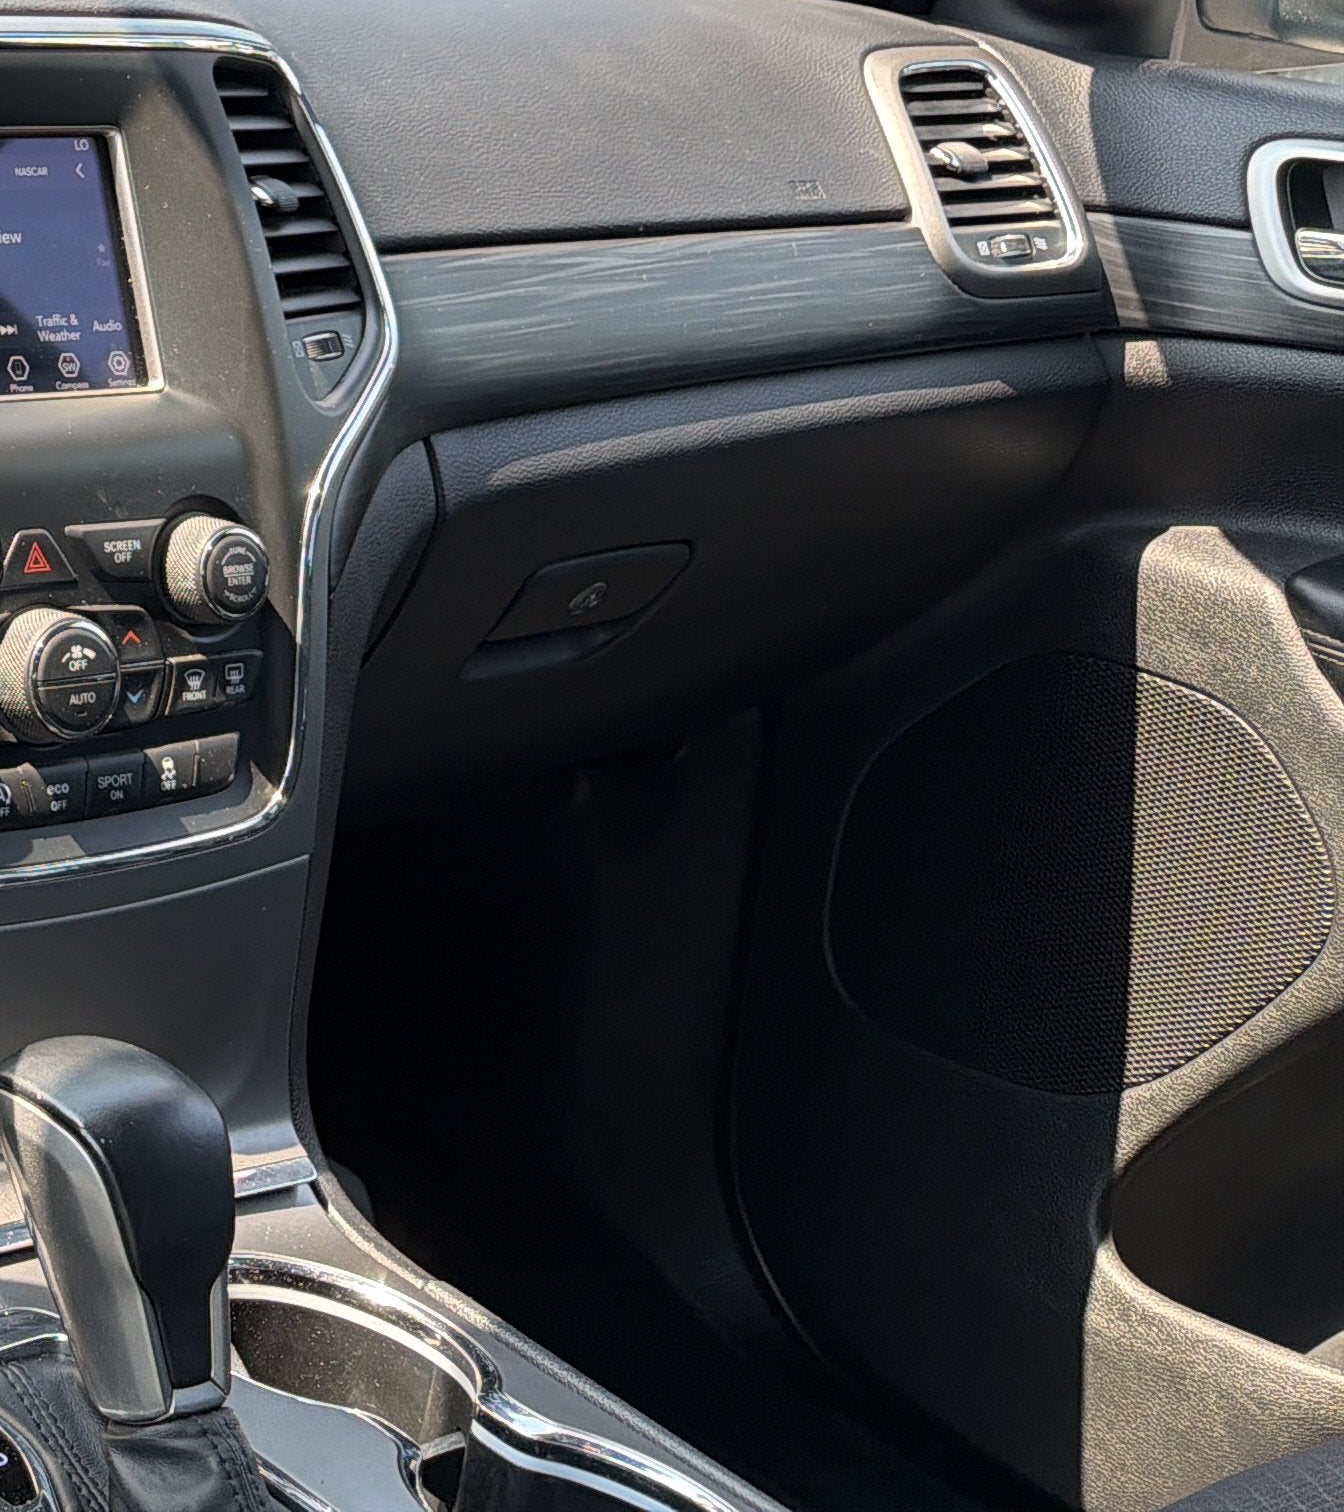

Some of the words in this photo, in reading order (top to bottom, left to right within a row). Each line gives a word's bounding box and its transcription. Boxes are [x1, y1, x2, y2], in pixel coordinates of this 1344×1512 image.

[73, 139, 89, 151] LO
[14, 166, 49, 177] NASCAR
[36, 313, 67, 327] Traffic
[69, 314, 79, 327] &
[93, 319, 123, 332] Audio
[37, 329, 81, 342] Weather
[103, 539, 142, 553] SCREEN
[114, 552, 133, 564] OFF
[223, 563, 255, 574] BROWSE
[227, 576, 252, 587] ENTER
[68, 659, 88, 672] OFF
[182, 689, 207, 702] FRONT
[225, 684, 246, 695] REAR
[69, 691, 97, 706] AUTO
[97, 772, 133, 789] SPORT
[161, 779, 178, 791] OFF
[46, 784, 70, 796] eco
[109, 789, 124, 801] ON
[50, 800, 68, 812] OFF
